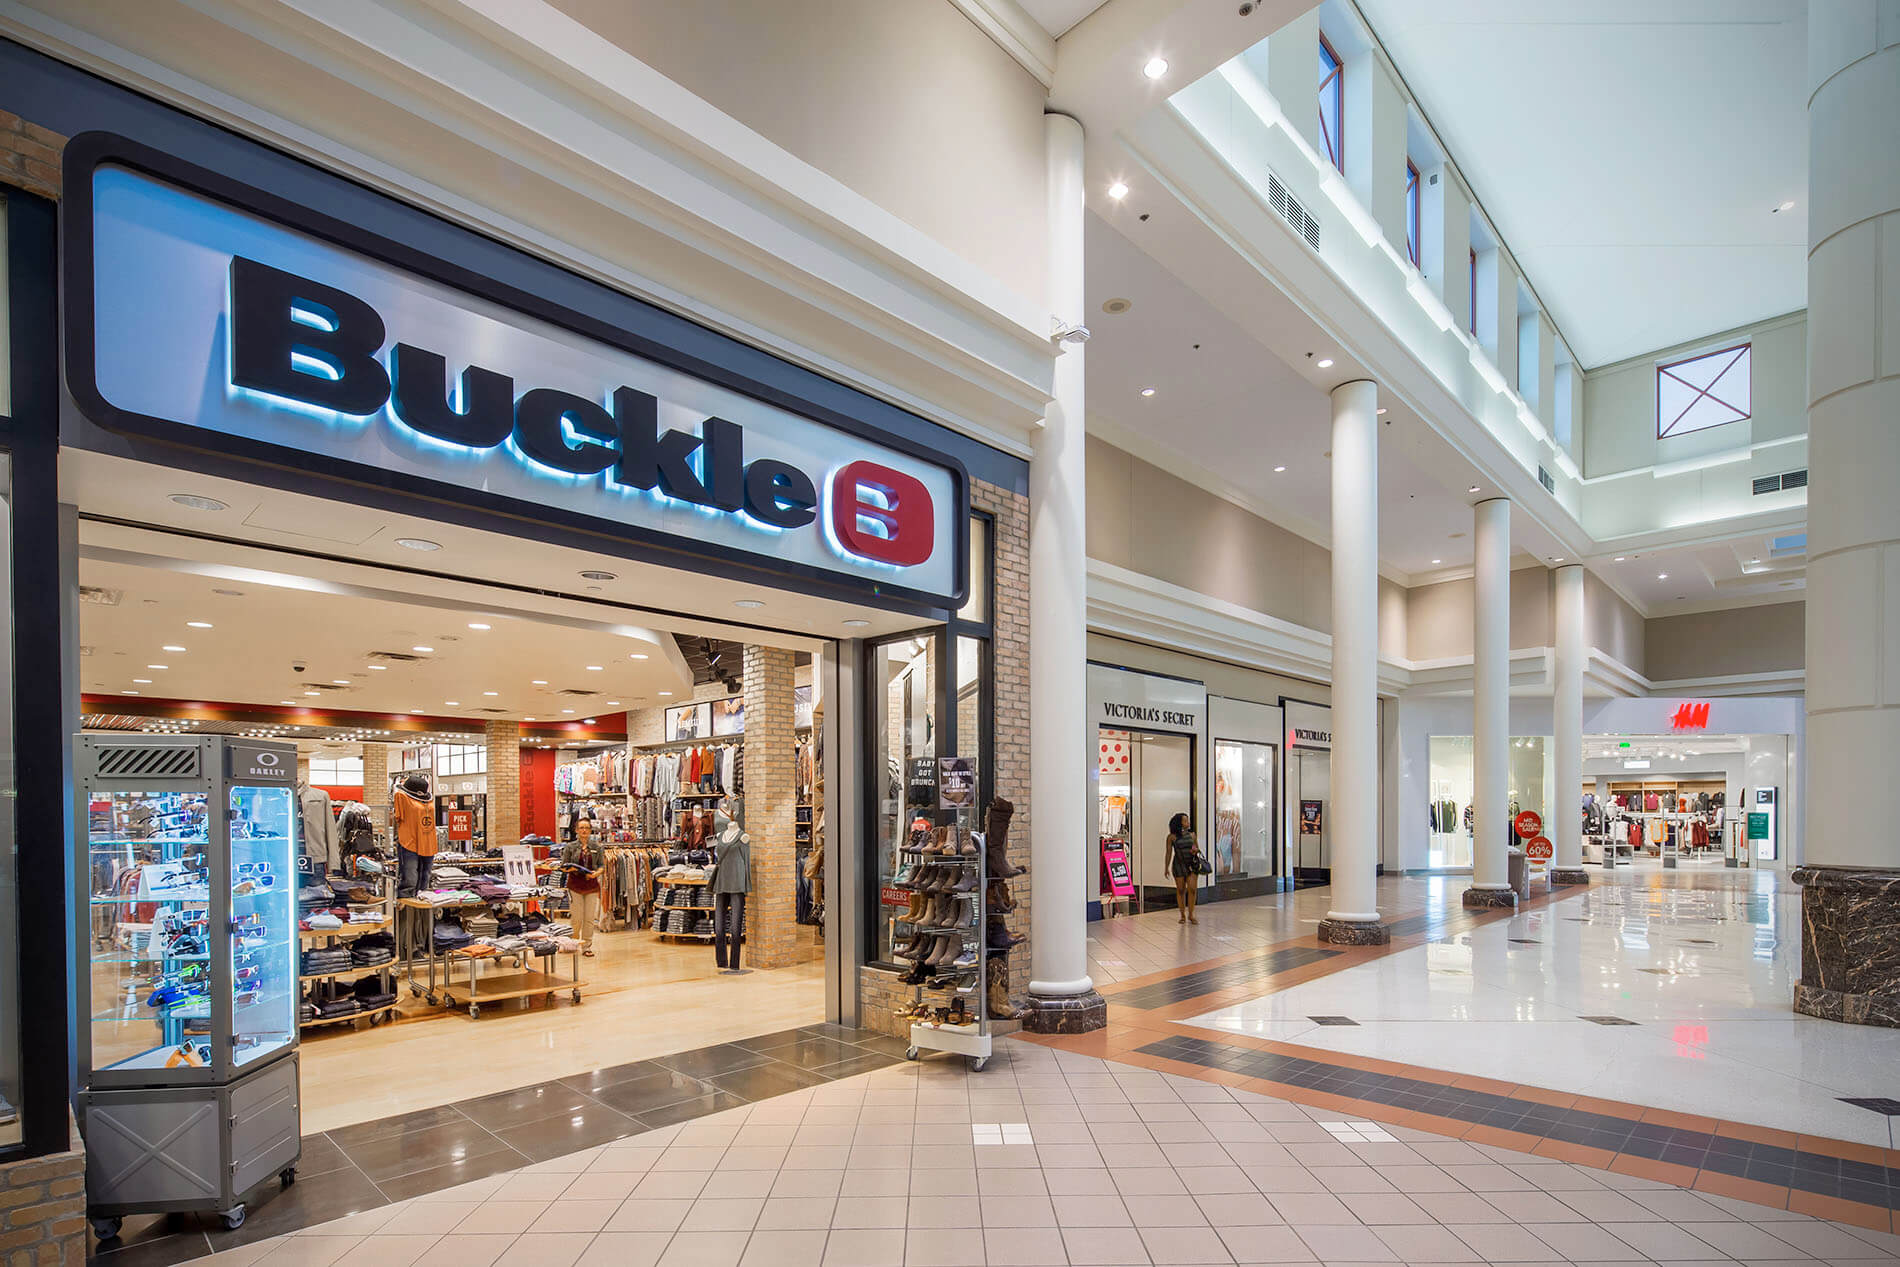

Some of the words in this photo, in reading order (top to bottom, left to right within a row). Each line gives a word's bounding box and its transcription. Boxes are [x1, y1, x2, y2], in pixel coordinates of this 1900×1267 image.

[229, 255, 817, 529] Buckle
[1104, 702, 1160, 722] VICTORIA'S
[1162, 711, 1195, 726] SECRET
[1295, 729, 1328, 742] VICTORIA'S
[249, 767, 286, 776] OAKLEY
[918, 769, 932, 777] GOT
[948, 776, 960, 788] $10
[523, 770, 535, 834] Buckle
[453, 815, 468, 823] PICK
[452, 824, 468, 832] WEEK
[1529, 846, 1551, 856] 60%
[883, 889, 907, 901] CAREERS
